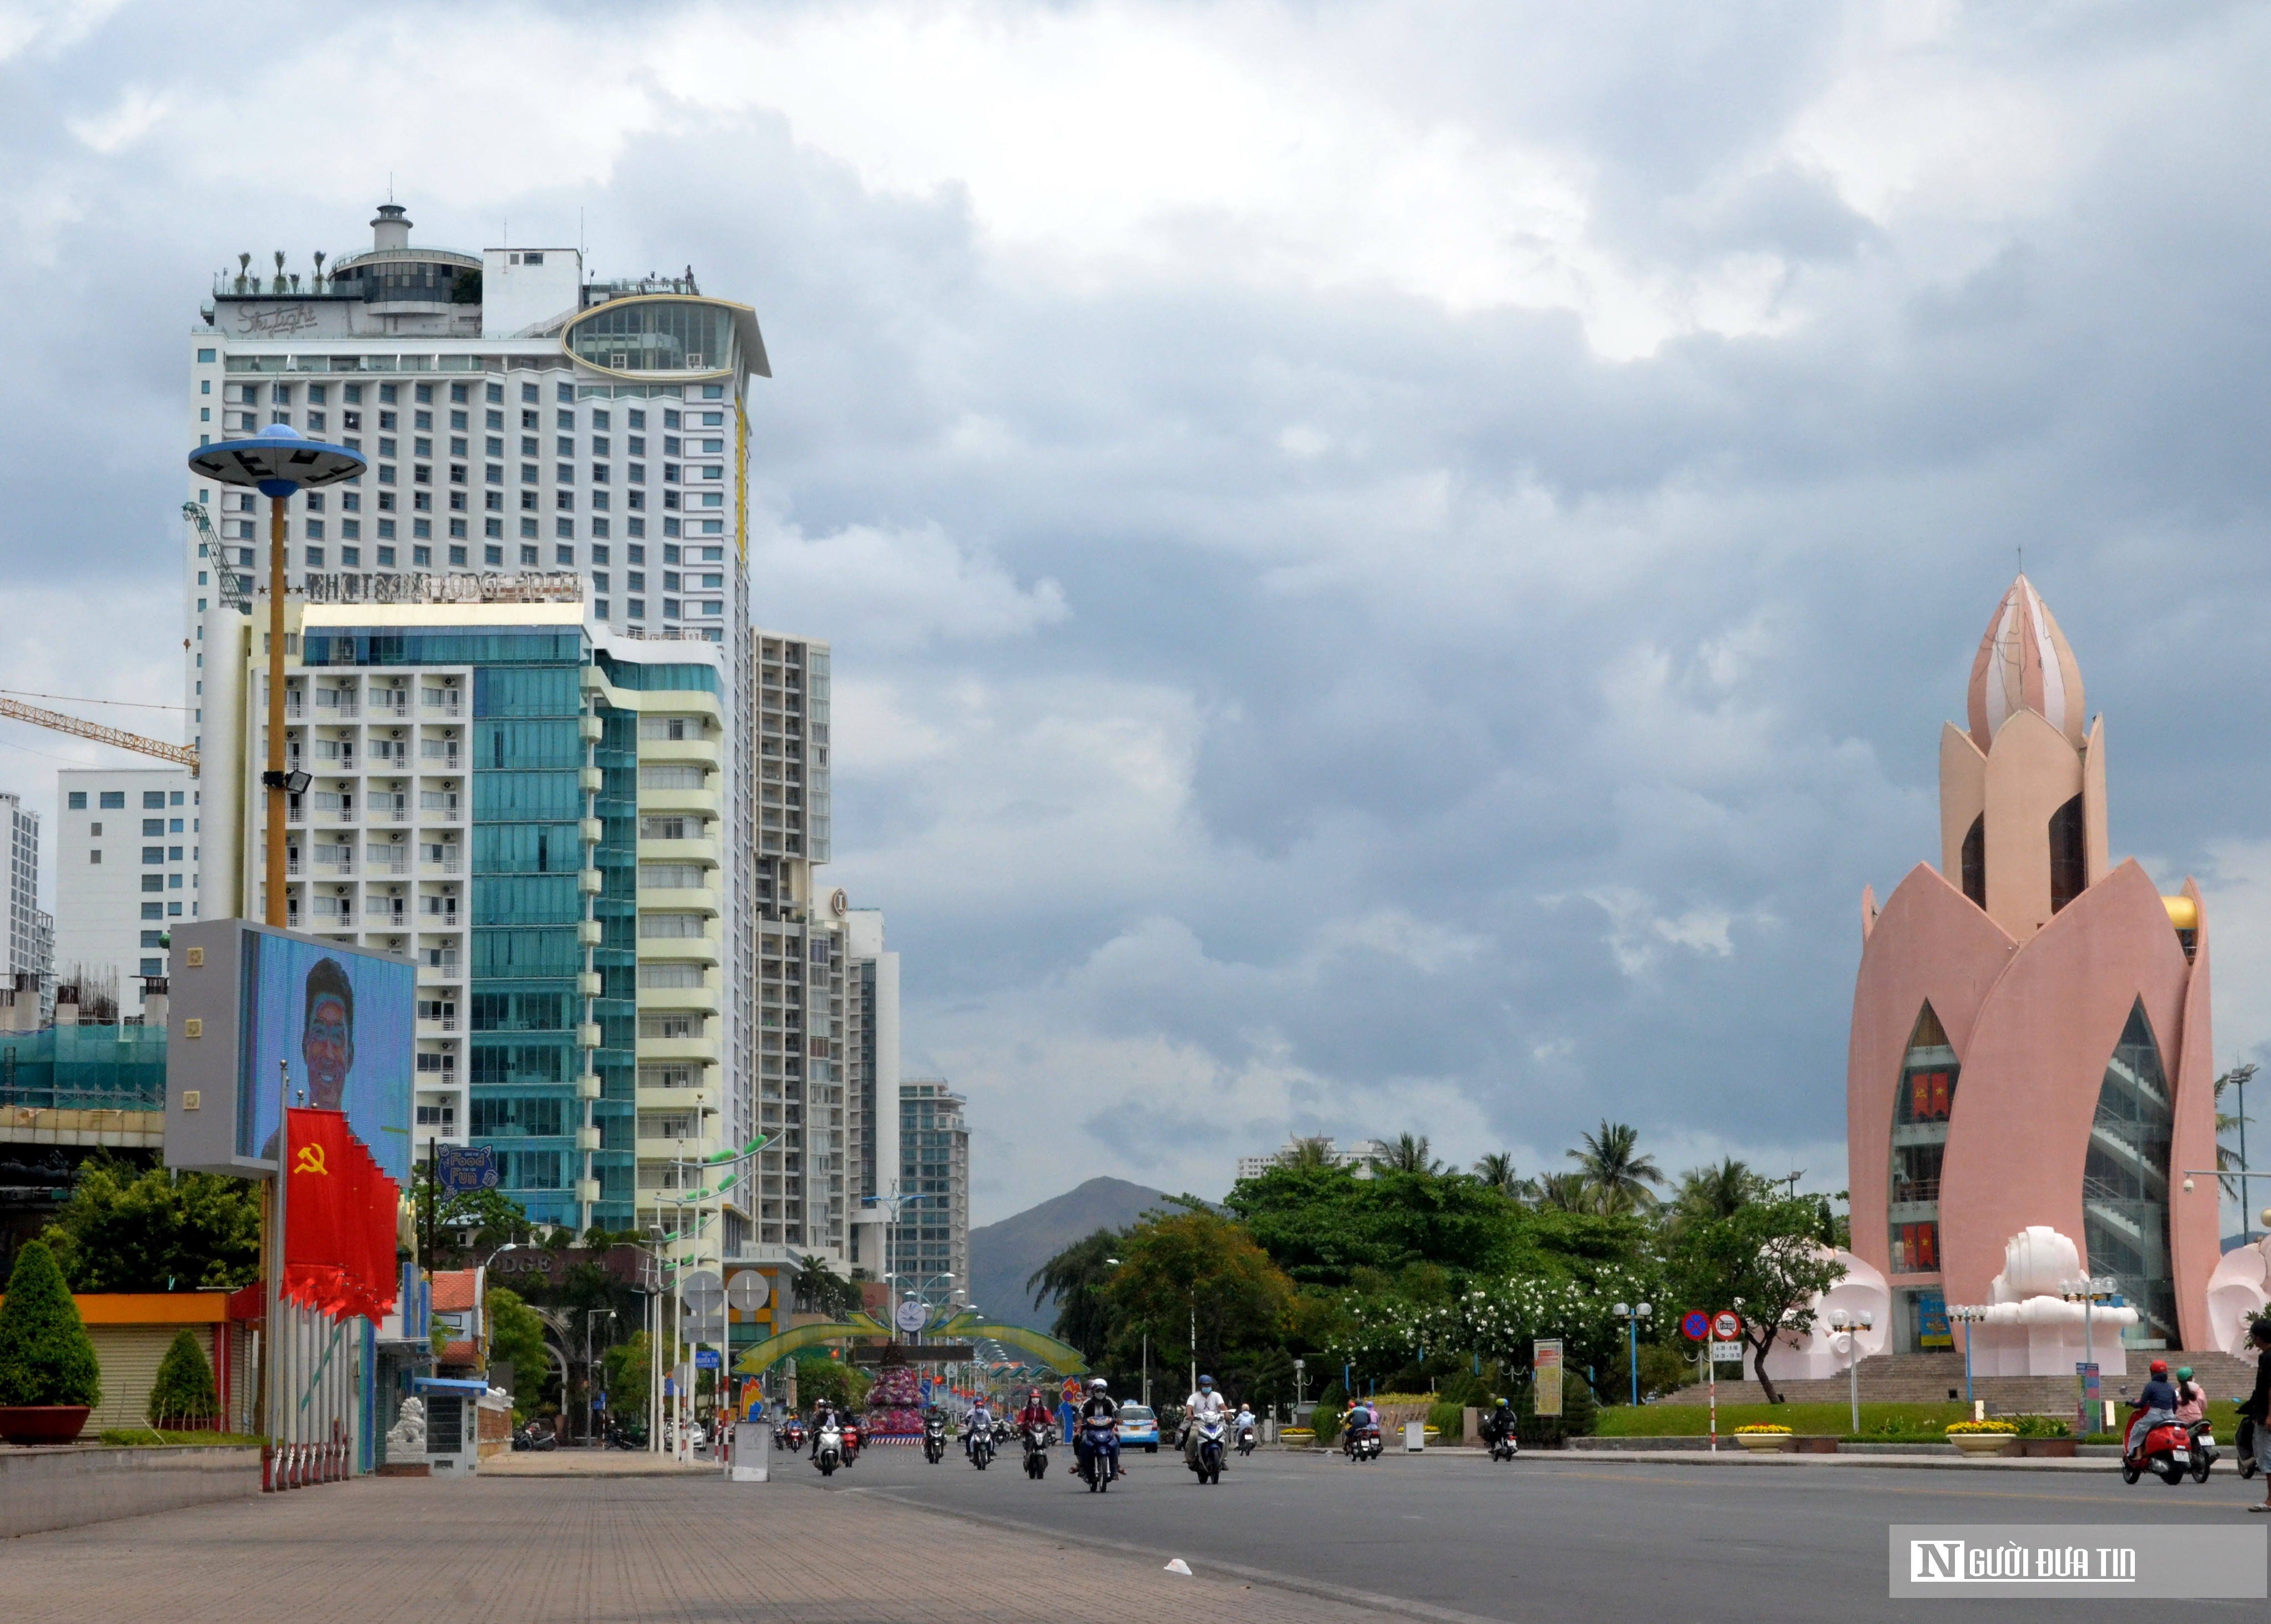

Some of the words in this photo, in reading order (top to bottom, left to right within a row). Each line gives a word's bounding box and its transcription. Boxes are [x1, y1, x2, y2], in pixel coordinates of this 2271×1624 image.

[439, 572, 507, 599] LODGE
[514, 572, 583, 598] HOTEL
[451, 1153, 484, 1166] Food
[450, 1168, 477, 1185] Fun
